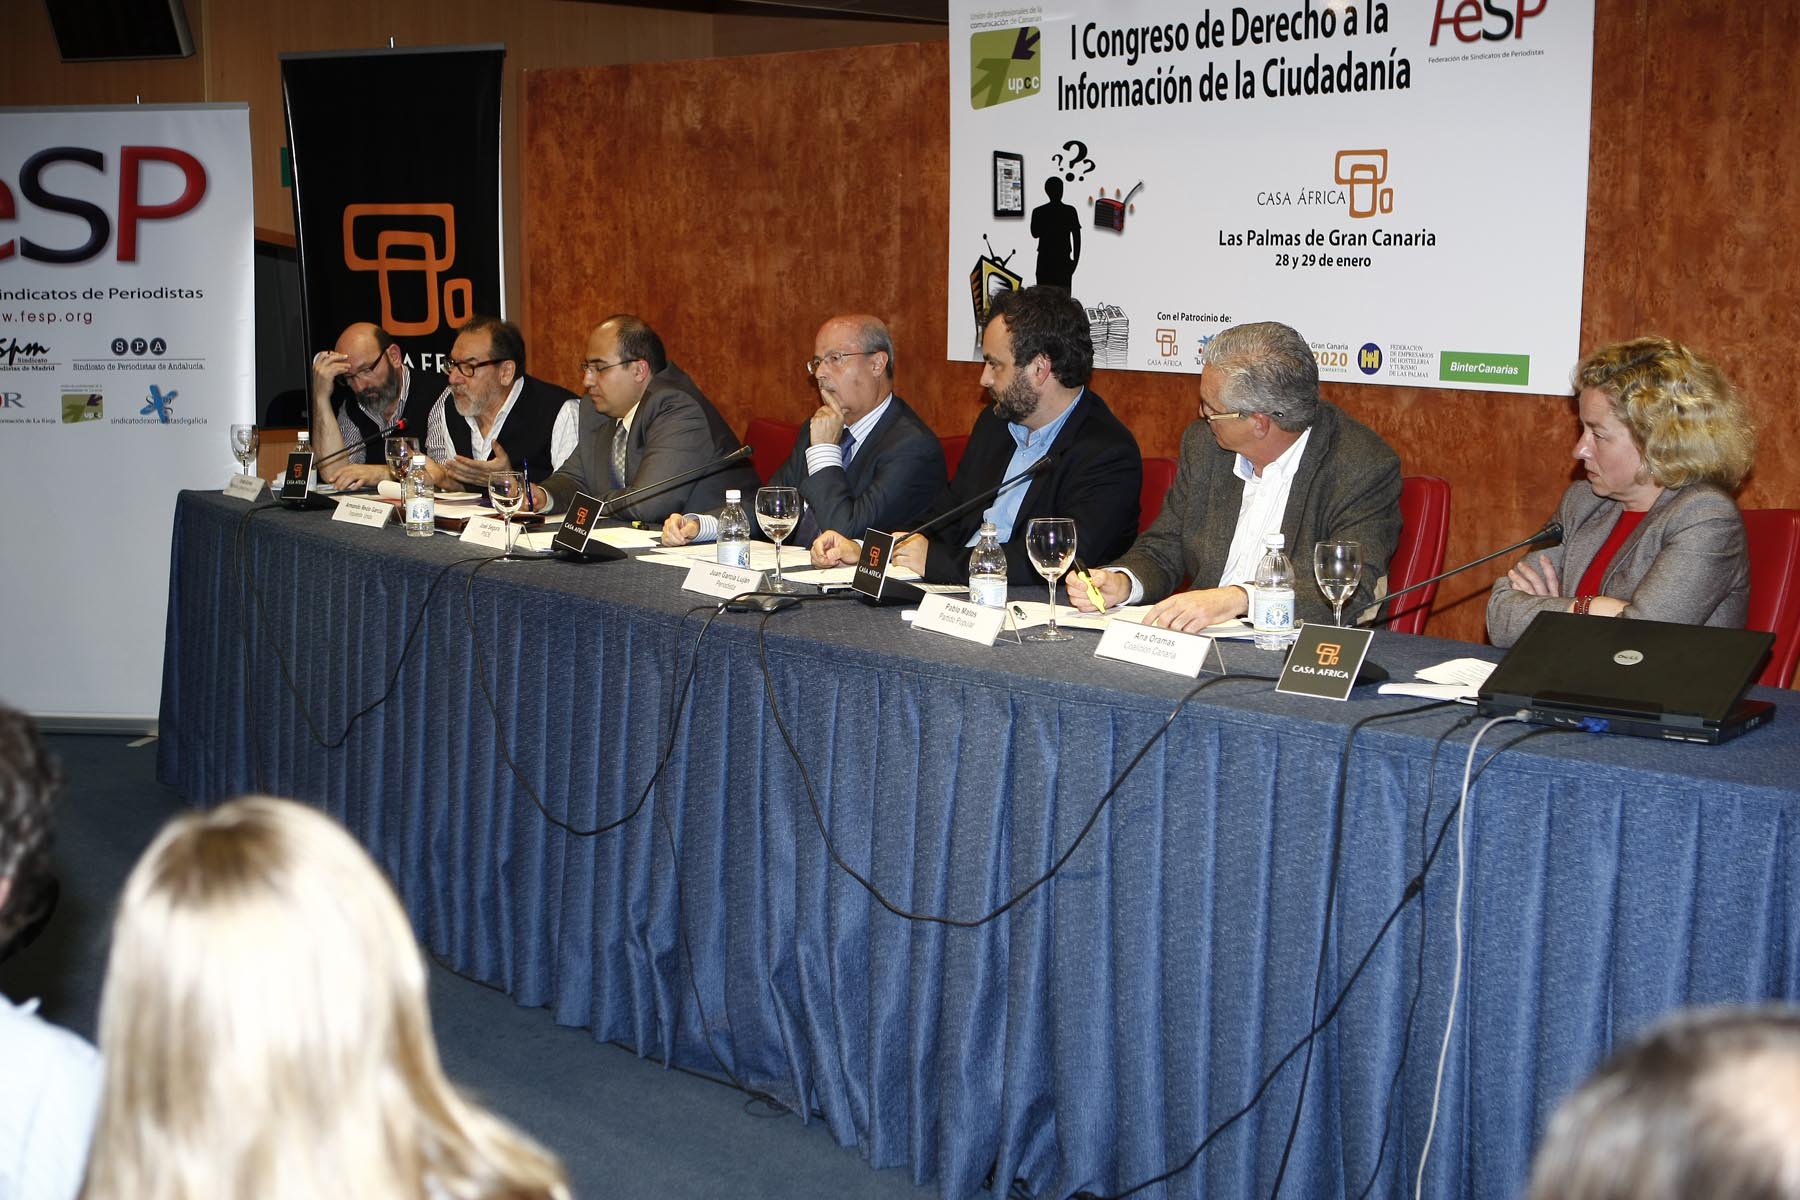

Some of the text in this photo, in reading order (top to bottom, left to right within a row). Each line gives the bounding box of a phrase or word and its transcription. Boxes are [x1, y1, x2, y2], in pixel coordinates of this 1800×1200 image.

[1082, 22, 1190, 66] Congreso
[1195, 8, 1225, 50] de
[1232, 0, 1337, 46] Derecho
[1343, 6, 1358, 36] a
[1366, 0, 1389, 34] la
[1428, 54, 1461, 64] Federación
[1461, 54, 1470, 62] de
[1470, 52, 1501, 60] Sindicatos
[1511, 48, 1544, 58] Periodistas
[1008, 76, 1040, 94] upcc
[1058, 46, 1411, 112] Información de la Ciudadanía
[1256, 187, 1346, 206] CASA ÁFRICA
[1219, 228, 1436, 246] Las Palmas de Gran Canaria
[1275, 253, 1372, 270] 28 y 29 de enero
[0, 286, 204, 300] indicatos de Periodistas
[2, 310, 94, 325] w.fesp.org
[1156, 312, 1232, 323] Con el Patrocinio de:
[1450, 362, 1520, 375] BinterCanarias
[564, 522, 575, 531] CASA
[710, 569, 721, 577] Juan
[858, 566, 869, 575] CASA
[945, 602, 977, 618] Pablo Matos
[938, 612, 955, 624] Partido
[1135, 632, 1176, 647] Ana Oramas
[1292, 665, 1349, 679] CASA AFRICA
